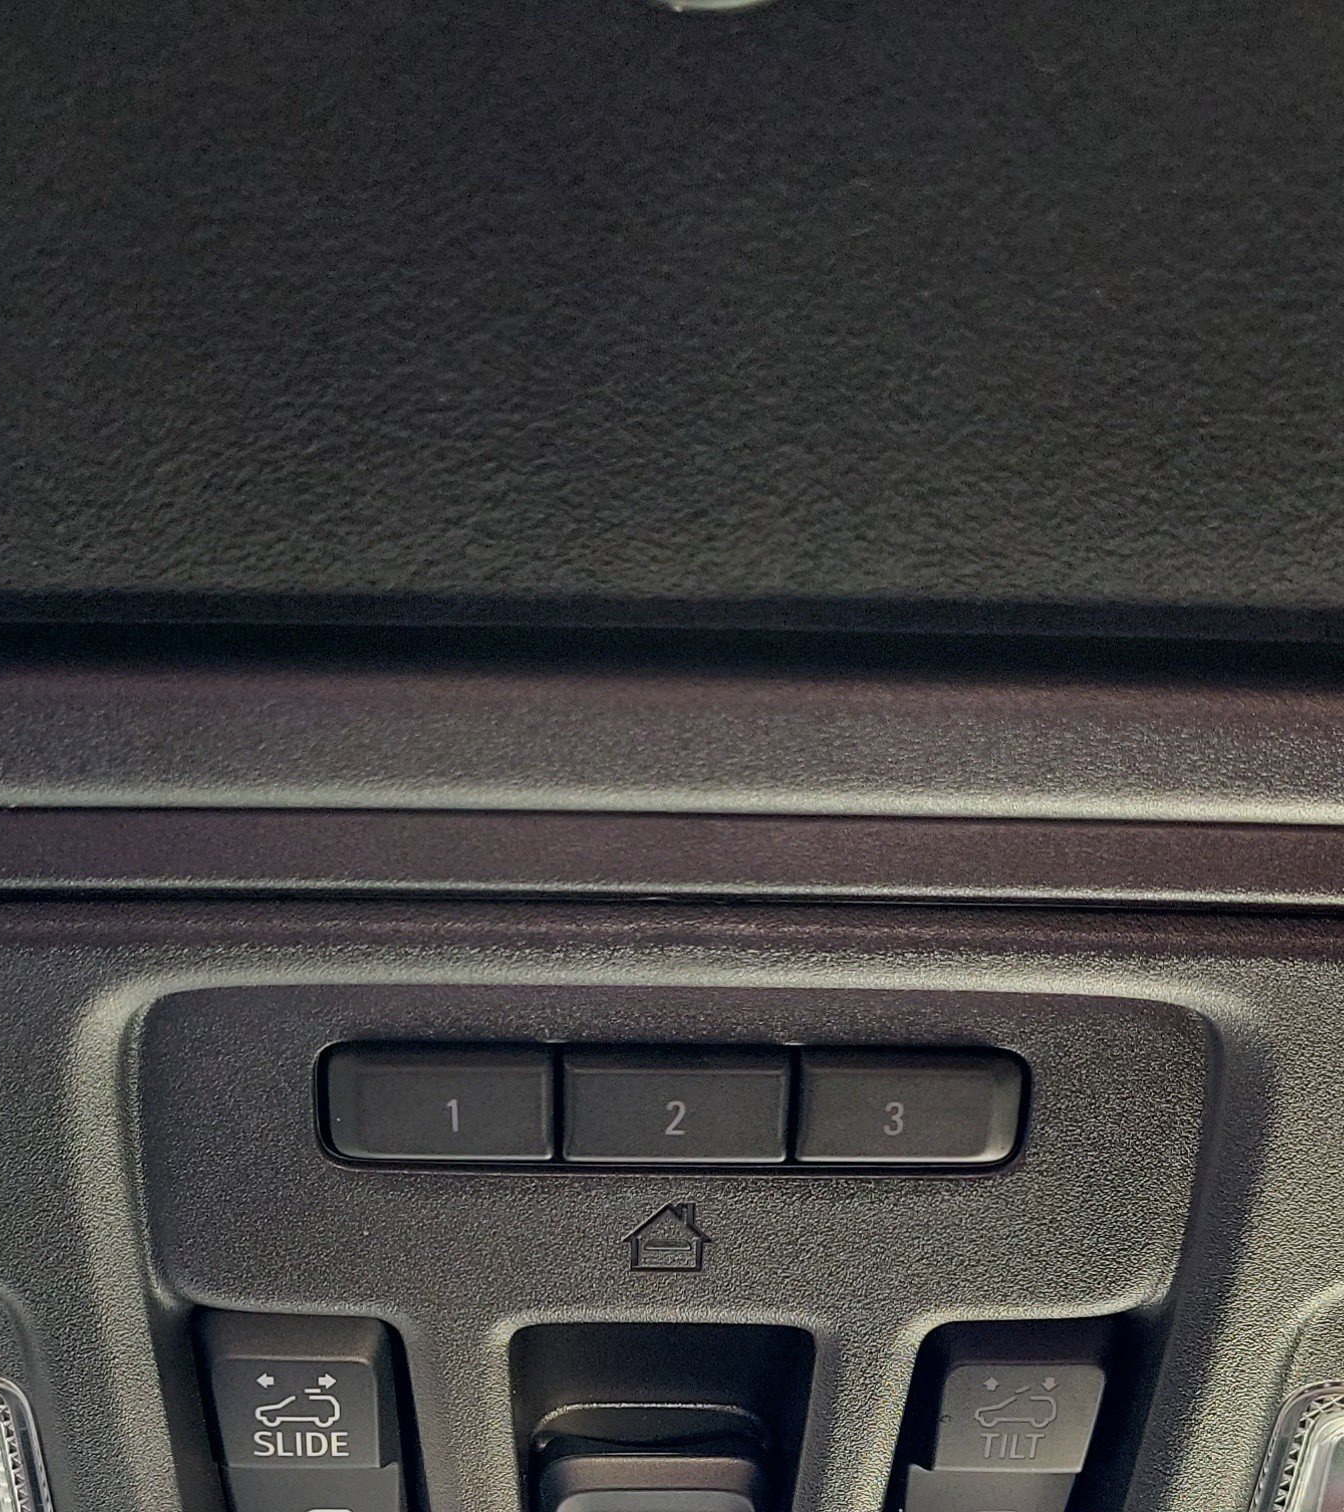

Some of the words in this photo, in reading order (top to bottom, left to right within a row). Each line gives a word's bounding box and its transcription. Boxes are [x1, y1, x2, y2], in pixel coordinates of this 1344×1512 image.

[445, 1099, 459, 1132] 1
[665, 1101, 686, 1135] 2
[883, 1102, 904, 1135] 3
[253, 1431, 350, 1457] SLIDE
[979, 1433, 1045, 1459] TILT
